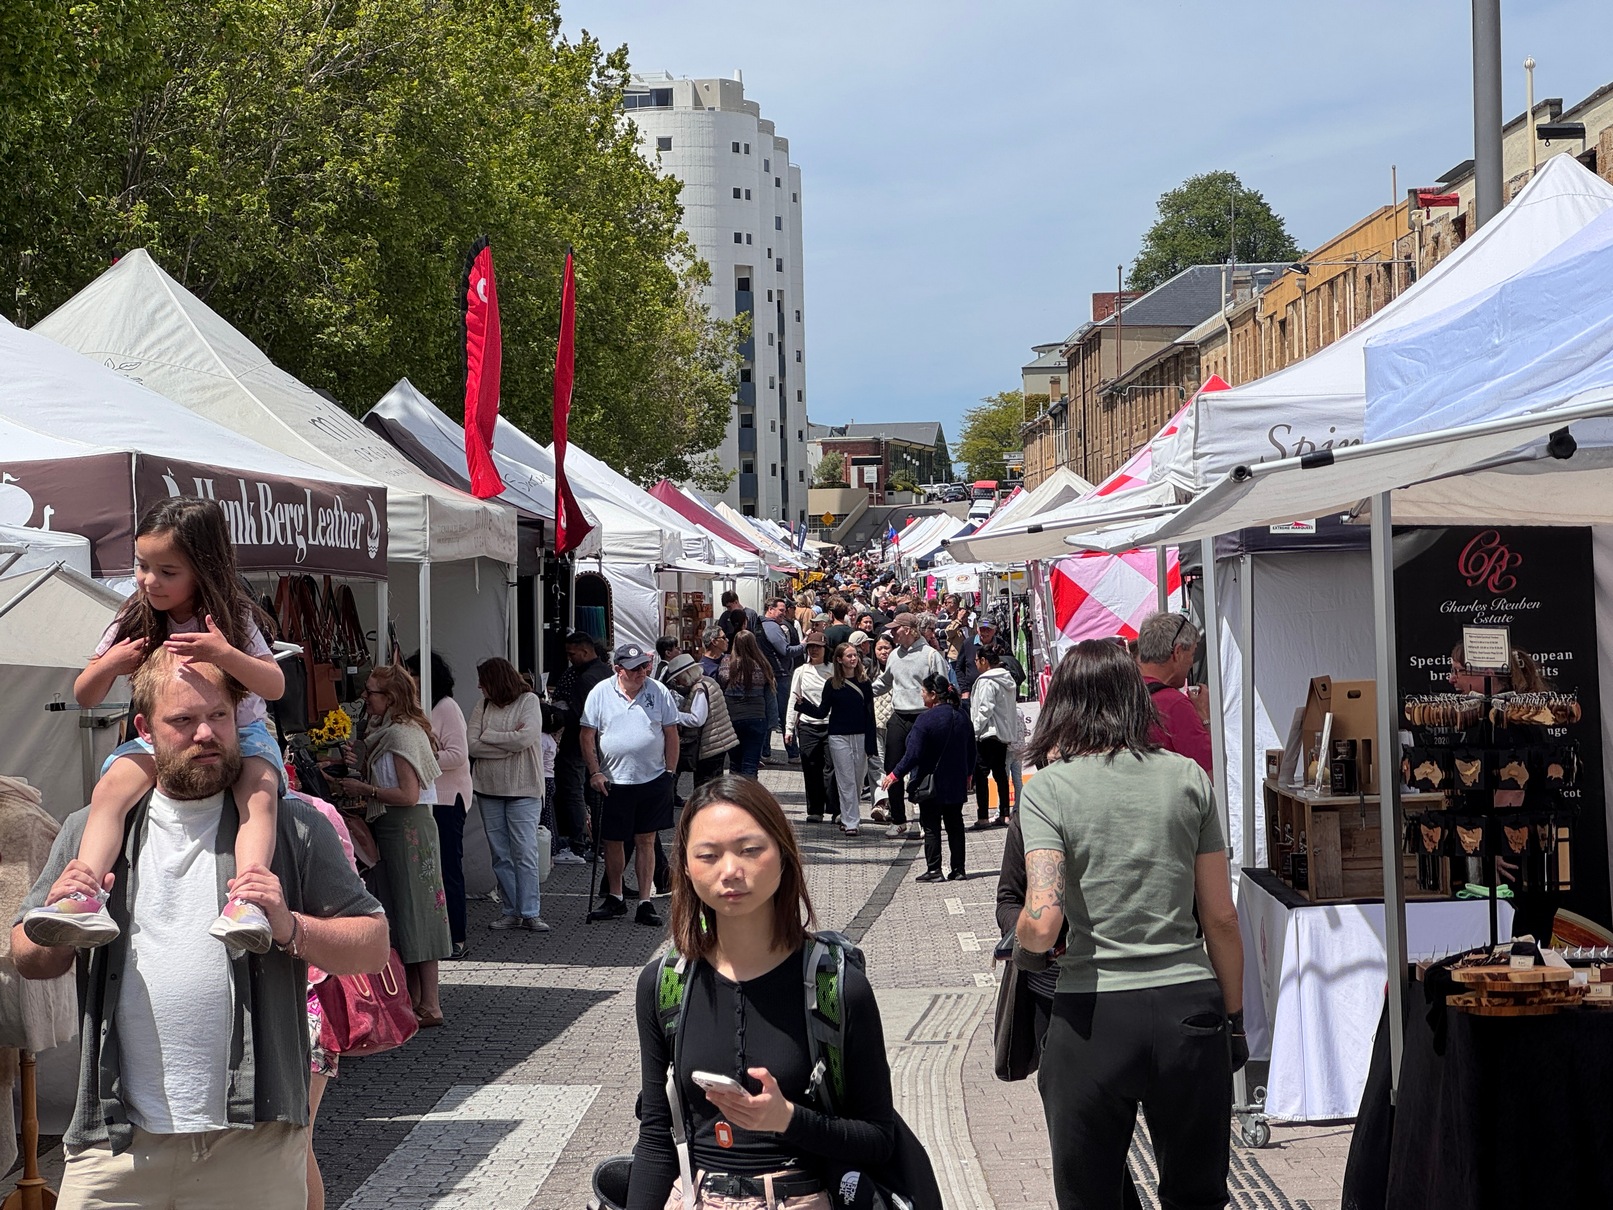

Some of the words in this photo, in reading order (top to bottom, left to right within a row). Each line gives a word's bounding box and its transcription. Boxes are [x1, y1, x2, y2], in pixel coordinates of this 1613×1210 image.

[256, 482, 307, 563] Berg
[304, 488, 365, 550] Leather
[1440, 600, 1487, 613] Charles
[1490, 597, 1541, 611] Reuben
[1473, 612, 1514, 624] Estate
[1410, 655, 1454, 668] Specia
